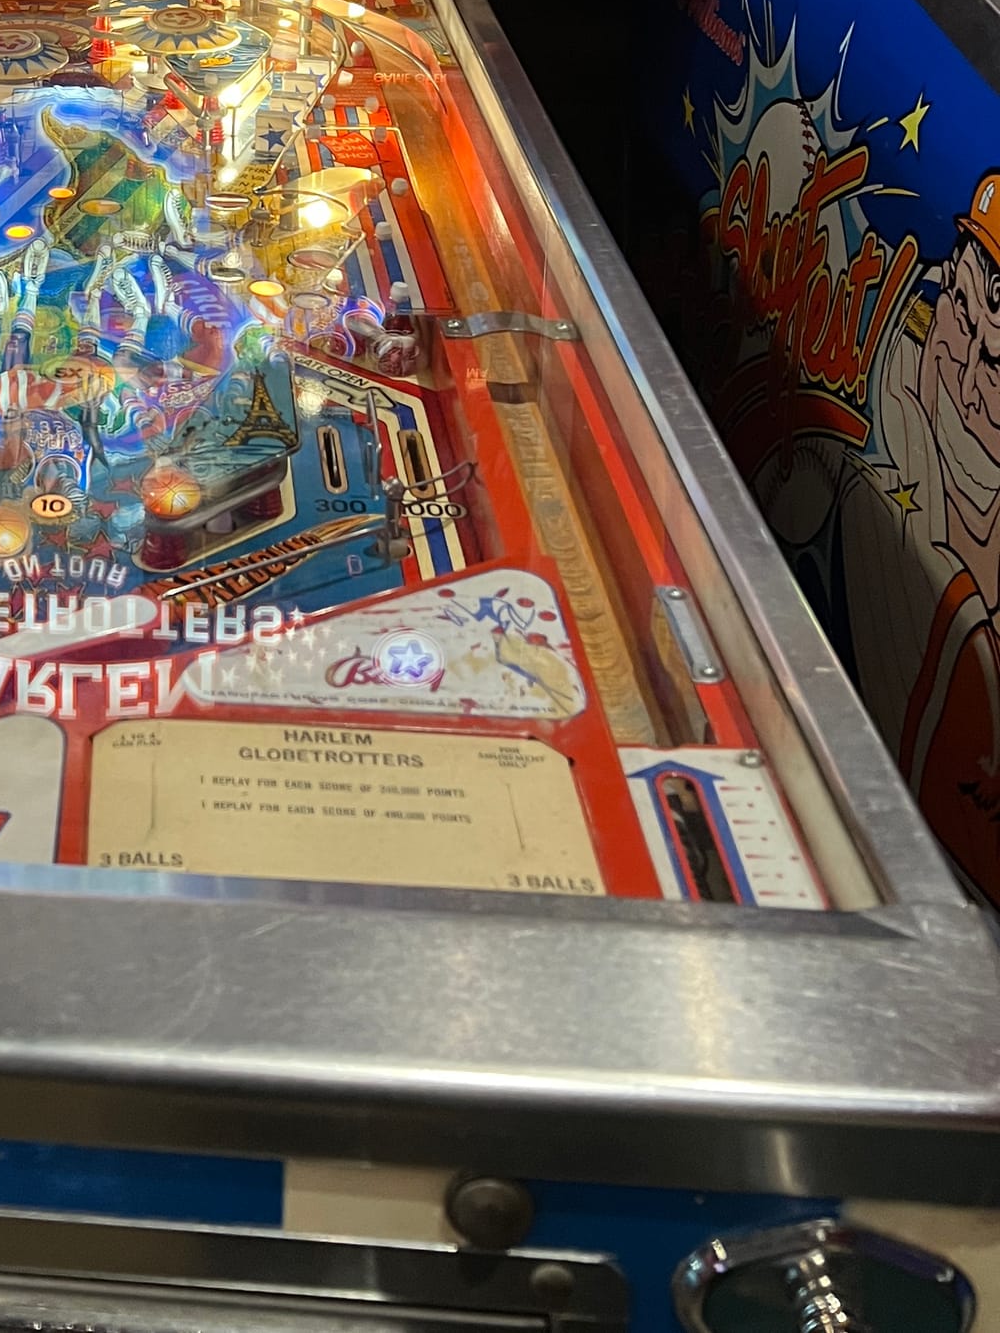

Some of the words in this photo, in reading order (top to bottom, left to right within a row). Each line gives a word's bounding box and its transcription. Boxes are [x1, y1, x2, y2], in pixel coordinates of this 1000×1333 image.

[294, 355, 327, 373] GATE
[327, 365, 369, 386] OPEN
[40, 498, 65, 514] 10
[314, 499, 367, 513] 300
[283, 729, 373, 746] HARLEM
[238, 746, 424, 769] GLOBETROTTERS
[212, 776, 251, 787] REPLAY
[257, 778, 277, 787] FOR
[284, 780, 312, 790] EACH
[319, 781, 352, 792] SCORE
[427, 787, 466, 798] POINTS
[213, 801, 252, 811] REPLAY
[259, 803, 280, 812] FOR
[287, 804, 315, 815] EACH
[322, 806, 357, 817] SCORE
[432, 812, 473, 824] POINTS
[117, 851, 184, 868] BALLS
[507, 872, 521, 889] 3
[526, 874, 595, 894] BALLS
